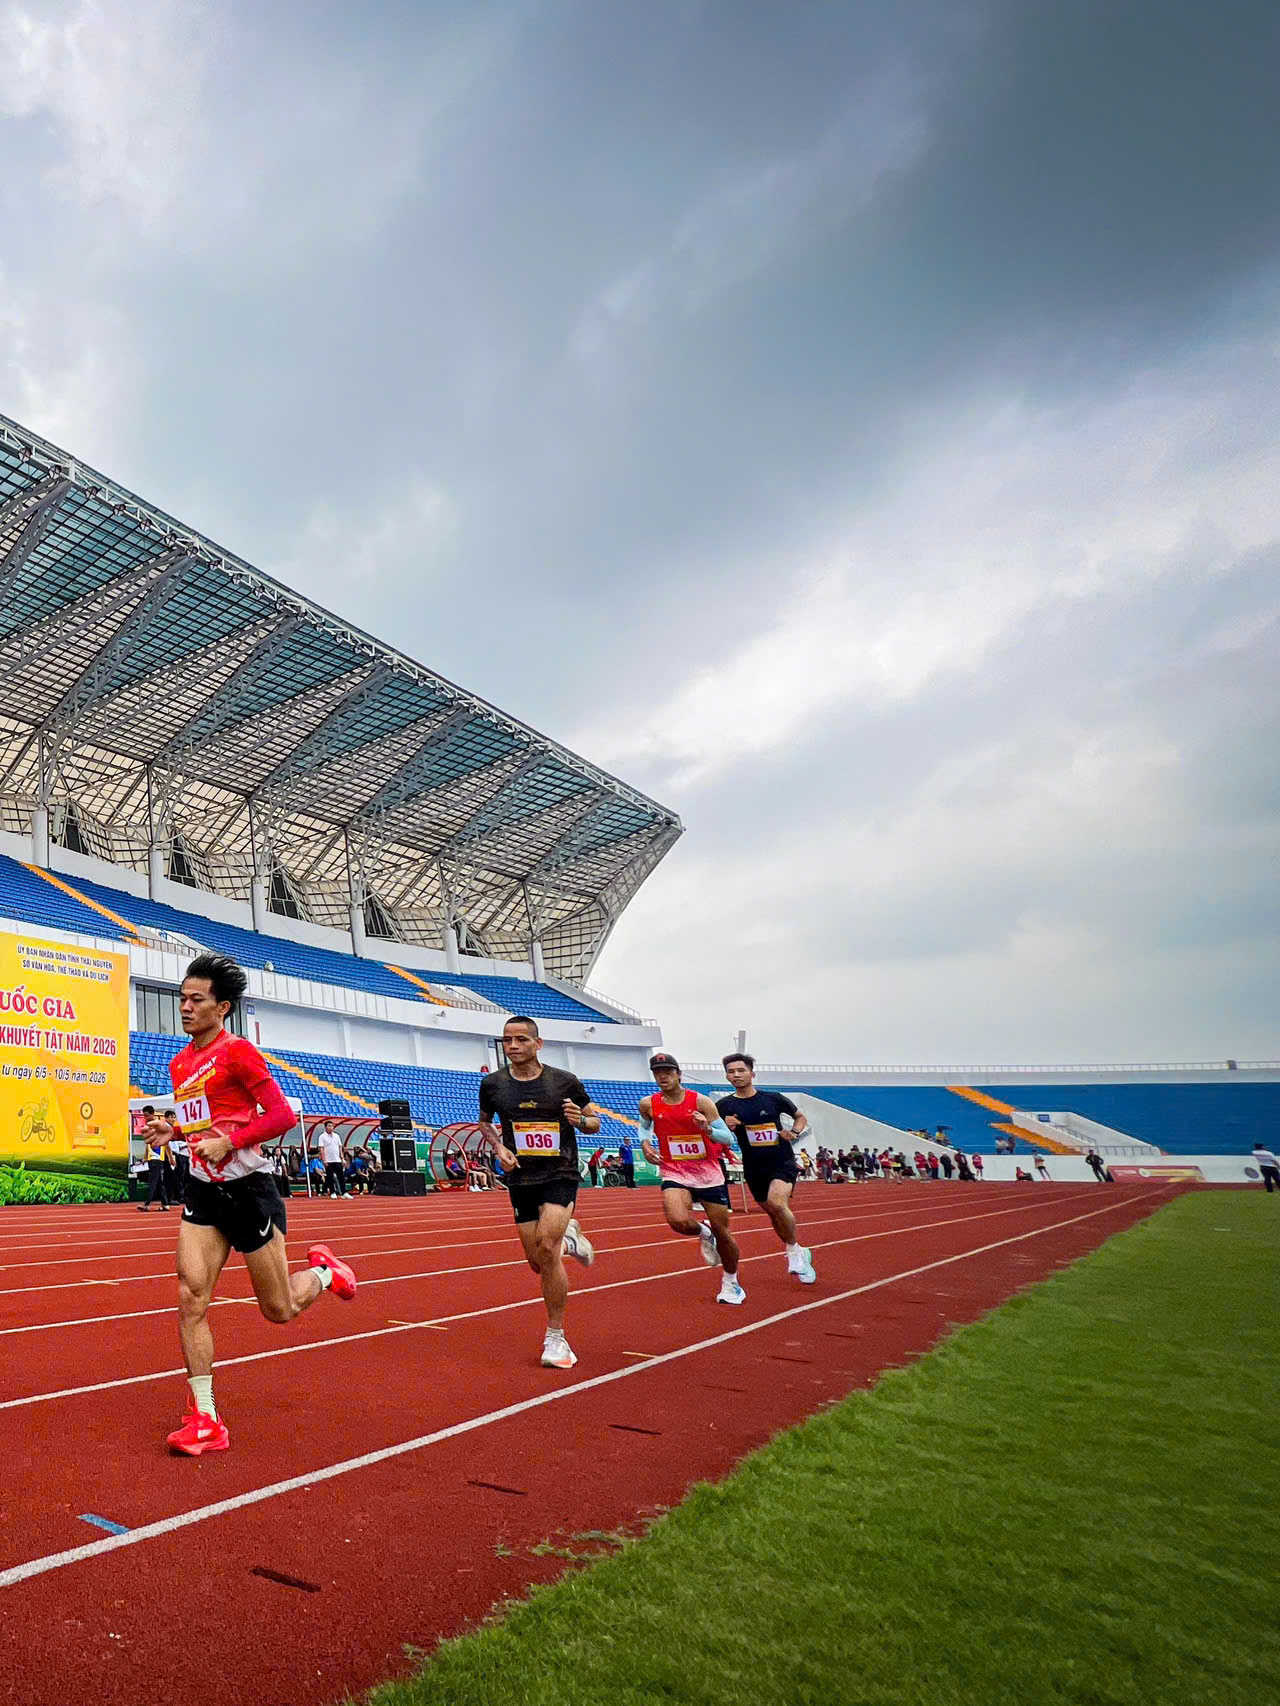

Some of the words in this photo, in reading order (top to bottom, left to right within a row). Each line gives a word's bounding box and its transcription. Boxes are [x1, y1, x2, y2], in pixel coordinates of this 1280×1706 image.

[43, 998, 75, 1020] GIA
[0, 1025, 41, 1047] KHUYẾT
[45, 1028, 64, 1053] TẬT
[66, 1031, 90, 1053] NĂM
[93, 1037, 116, 1056] 2026
[35, 1066, 47, 1078] 6/5
[55, 1068, 70, 1081] 10/5
[89, 1071, 106, 1083] 2026
[182, 1099, 202, 1122] 147
[525, 1133, 553, 1148] 036
[754, 1130, 773, 1142] 217
[677, 1143, 700, 1154] 148
